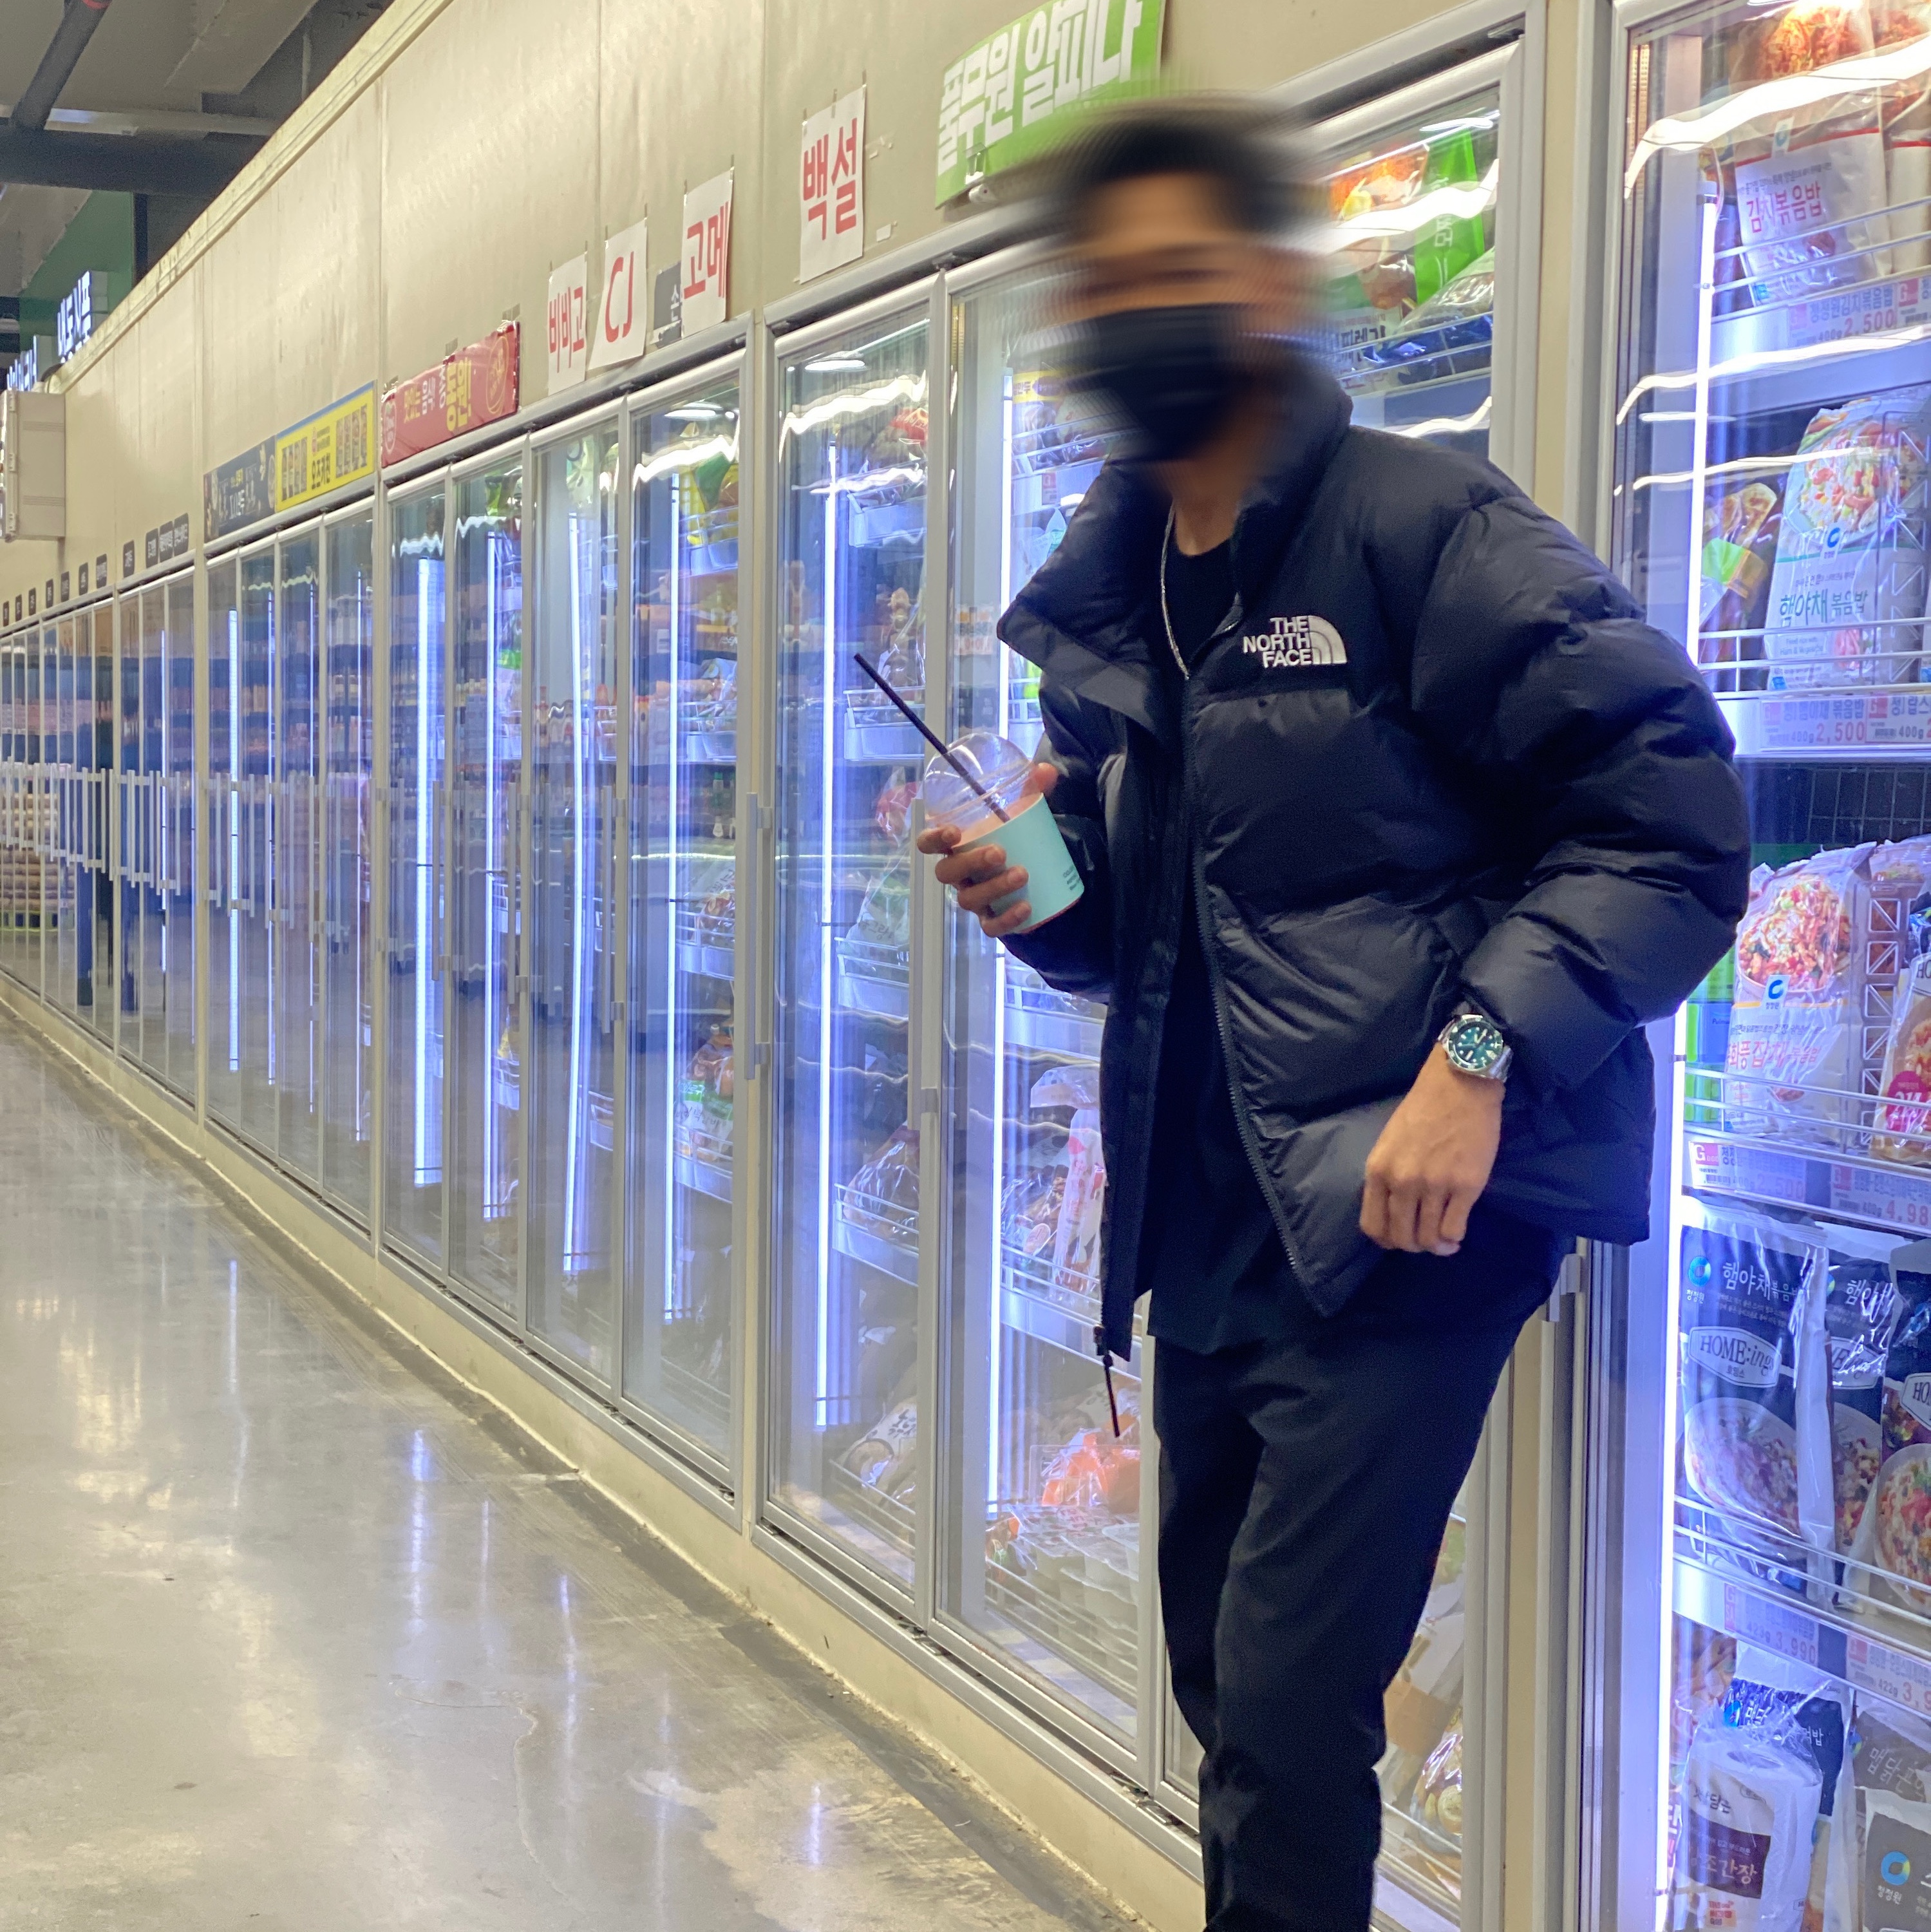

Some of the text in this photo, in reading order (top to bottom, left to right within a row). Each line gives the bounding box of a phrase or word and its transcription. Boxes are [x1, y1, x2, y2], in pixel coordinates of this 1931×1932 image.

[938, 23, 1021, 176] 풀무원
[803, 118, 858, 240] 백설
[684, 201, 730, 299] 고메
[605, 251, 634, 343] CJ
[549, 286, 585, 374] 비비고
[1270, 616, 1309, 634] THE
[1243, 632, 1311, 654] NORTH
[1263, 649, 1312, 668] FACE
[1816, 721, 1865, 744] 2,500
[1686, 1289, 1705, 1304] 청정원
[1723, 1262, 1771, 1301] 햄야채
[1878, 1884, 1902, 1905] 청정원
